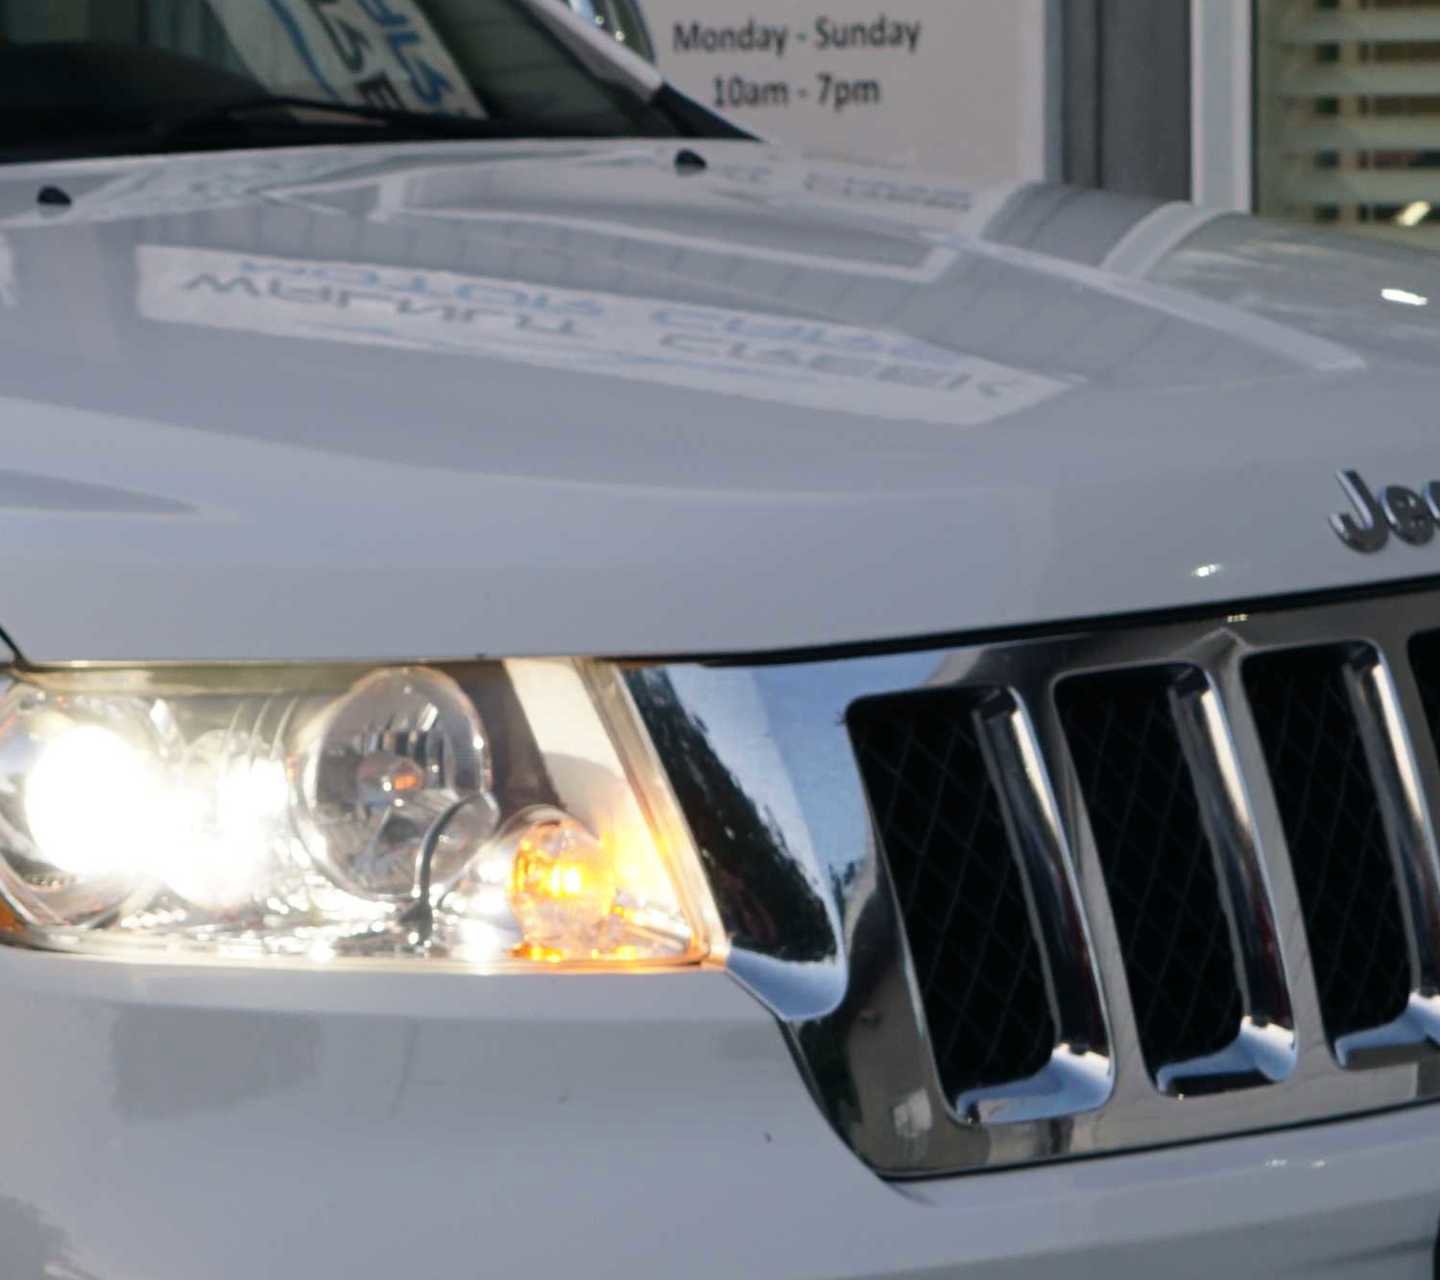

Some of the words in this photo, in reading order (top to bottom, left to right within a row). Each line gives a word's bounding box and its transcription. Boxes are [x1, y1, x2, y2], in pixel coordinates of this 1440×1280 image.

[672, 14, 788, 59] Monday
[814, 13, 922, 54] Sunday
[713, 73, 789, 108] 10am
[817, 72, 881, 113] 7pm
